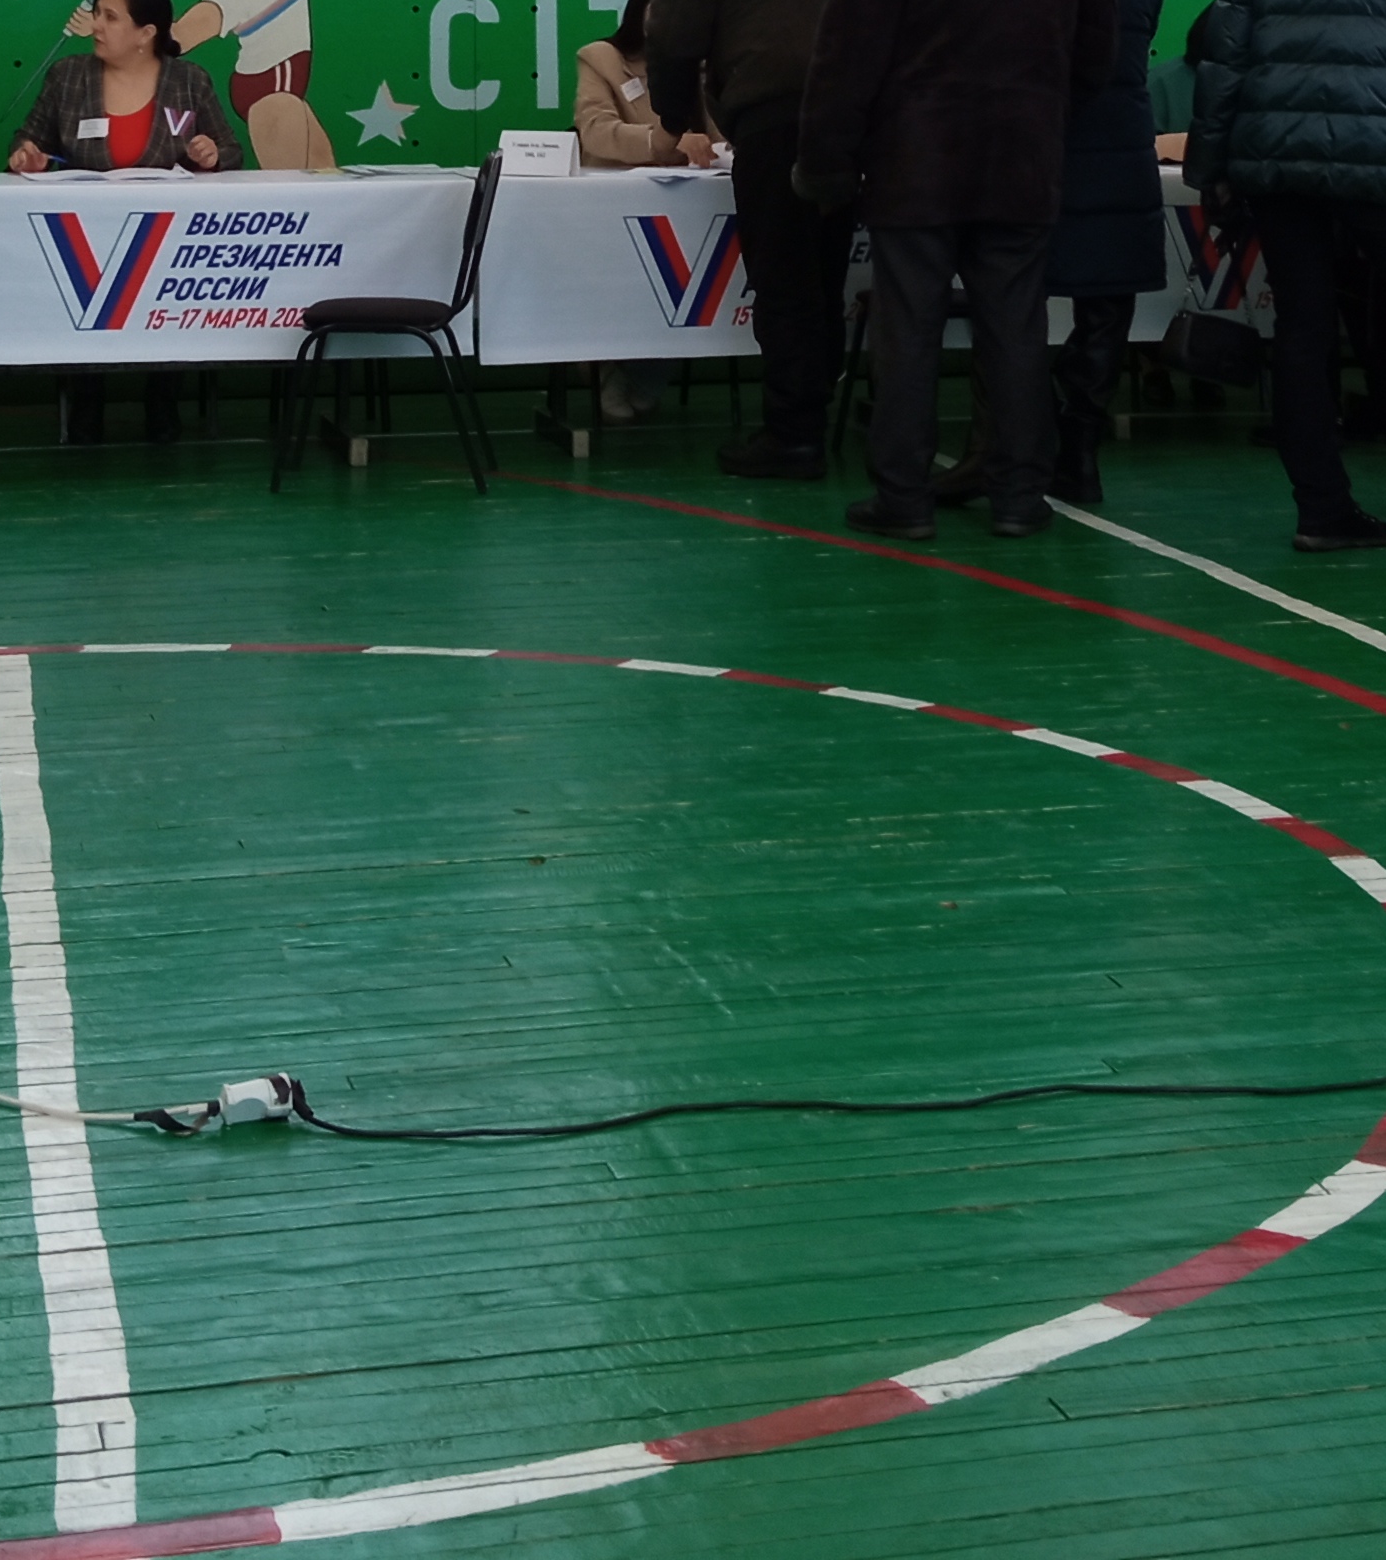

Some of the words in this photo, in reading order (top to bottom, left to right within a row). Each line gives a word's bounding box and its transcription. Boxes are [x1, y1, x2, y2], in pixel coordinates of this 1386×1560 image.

[185, 211, 311, 236] ВЫБОРЫ
[169, 243, 344, 272] ПРЕЗИДЕНТА
[154, 276, 271, 302] РОССИИ
[199, 307, 270, 330] МАРТА
[269, 306, 309, 329] 202
